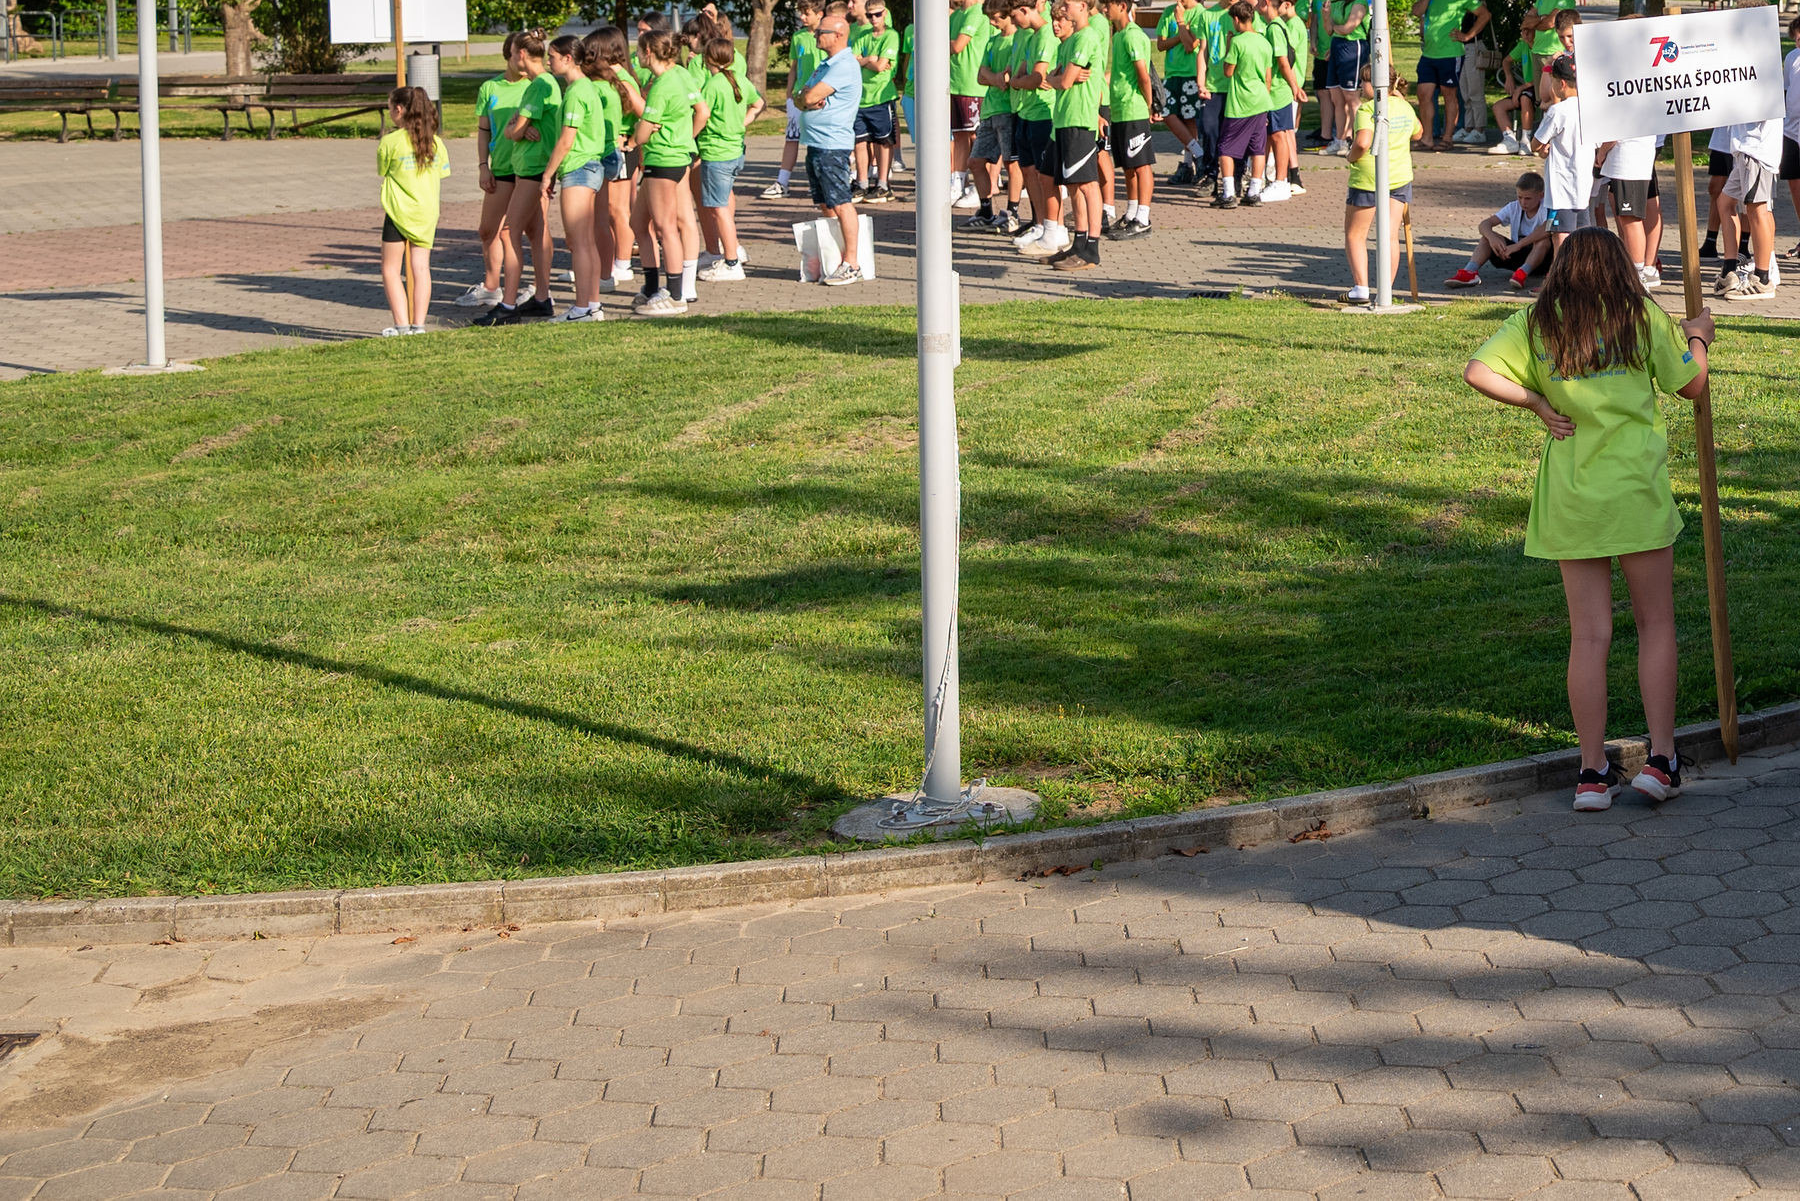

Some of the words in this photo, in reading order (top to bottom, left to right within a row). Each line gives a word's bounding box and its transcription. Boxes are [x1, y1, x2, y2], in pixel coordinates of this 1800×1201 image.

[1607, 73, 1692, 97] SLOVENSKA
[1695, 65, 1757, 87] ŠPORTNA
[1666, 96, 1711, 115] ZVEZA
[1129, 132, 1146, 150] NIKE
